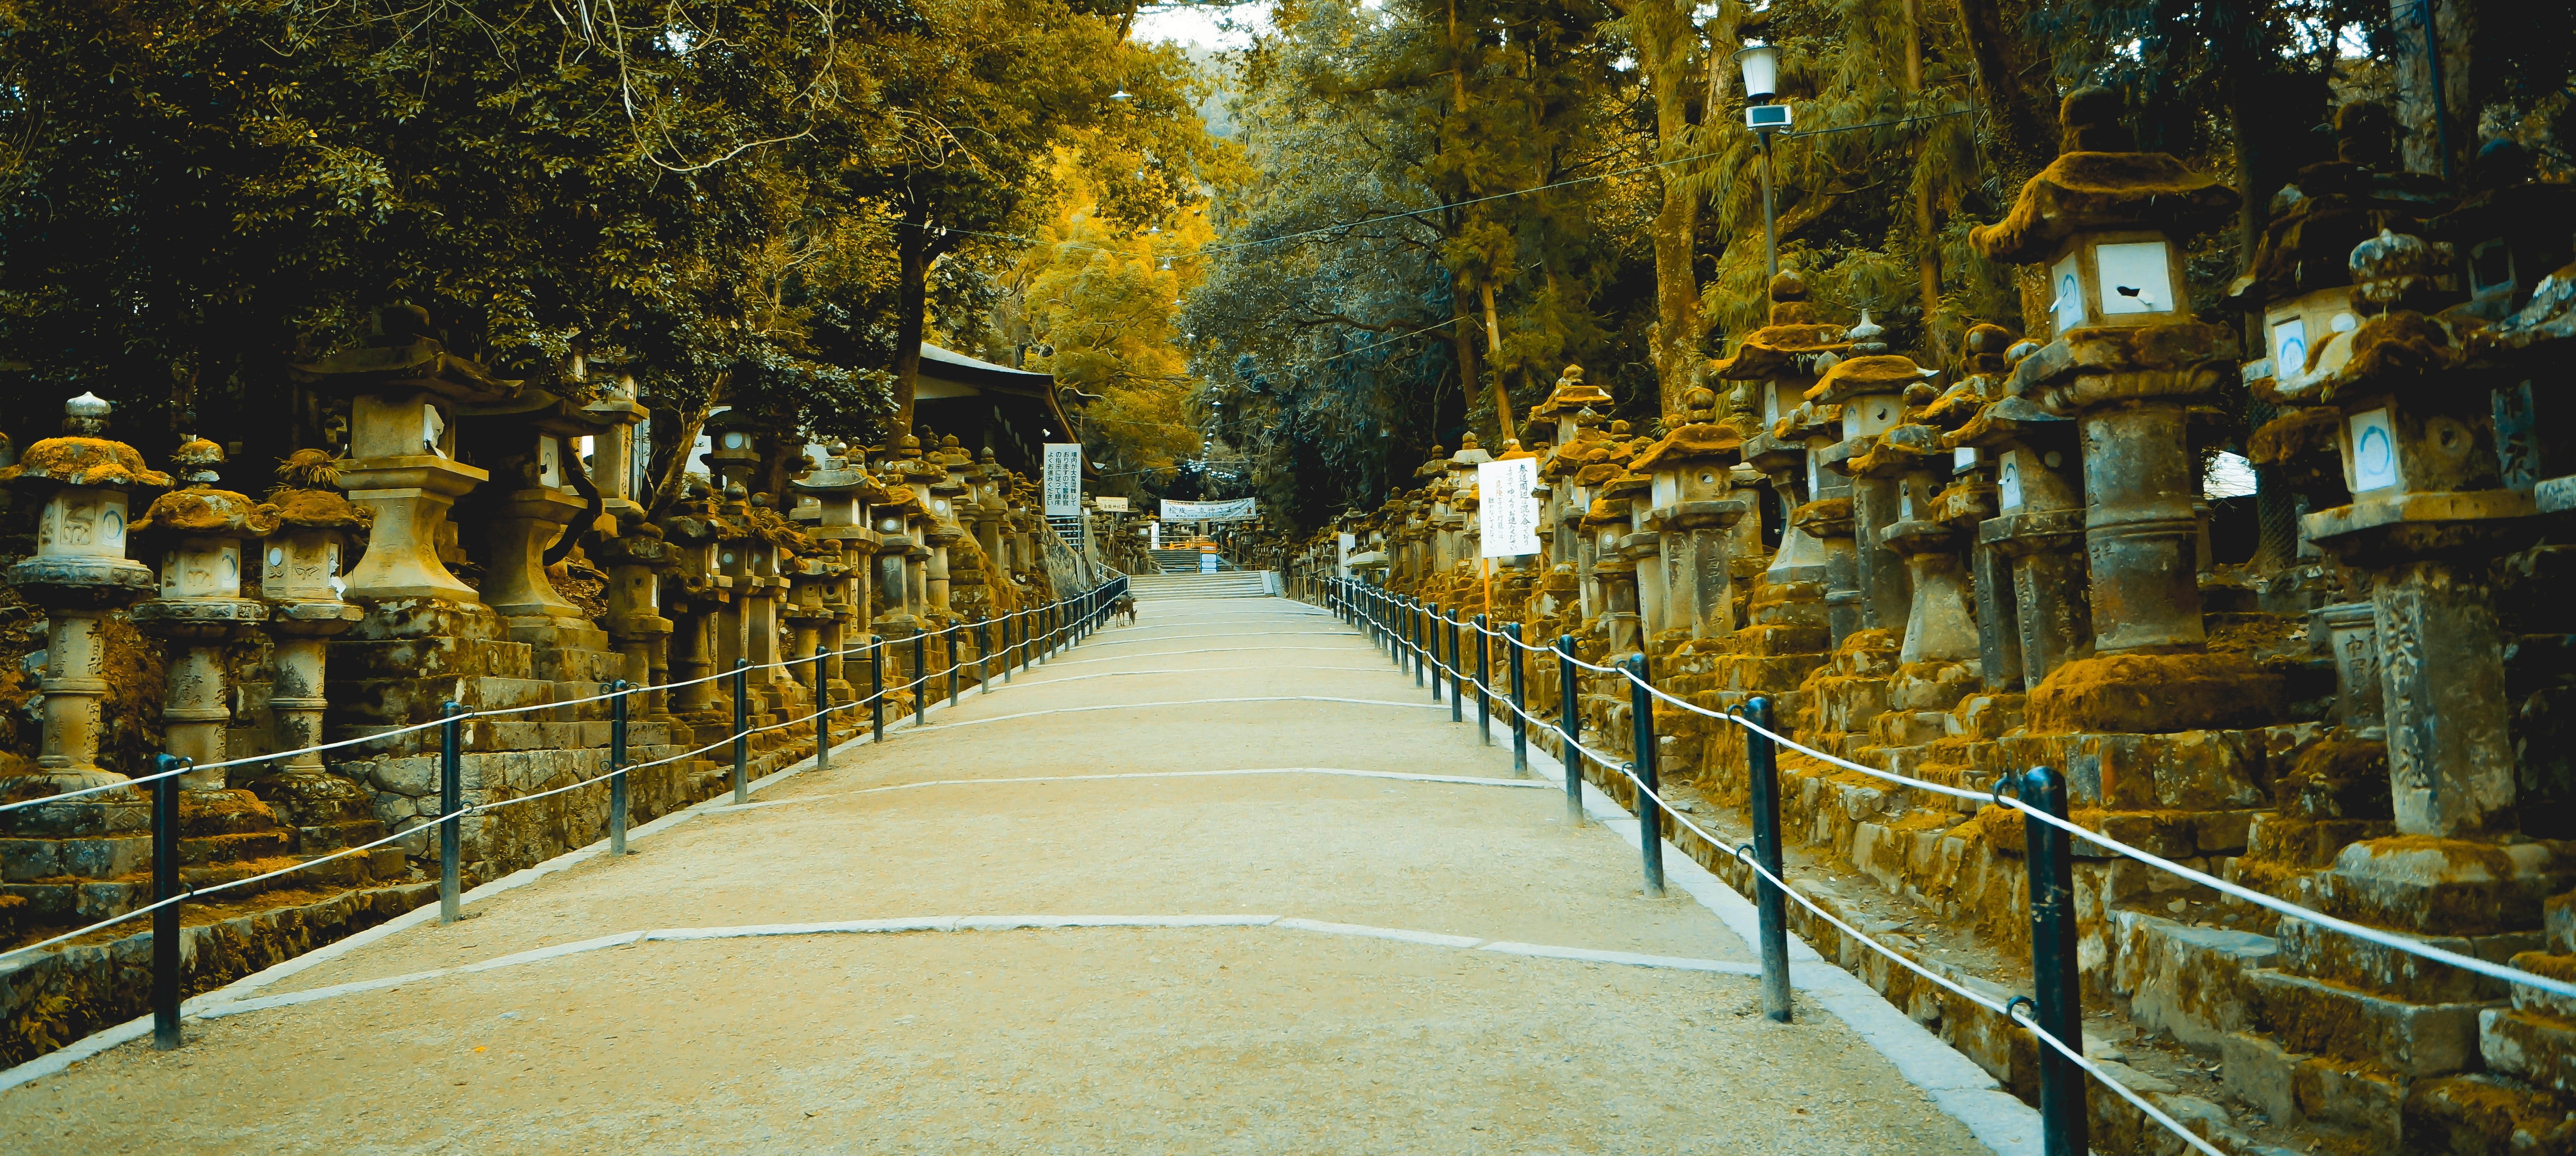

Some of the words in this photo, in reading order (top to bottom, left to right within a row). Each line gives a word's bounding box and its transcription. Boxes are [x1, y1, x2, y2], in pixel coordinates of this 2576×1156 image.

[1518, 463, 1531, 546] 参道周辺は混み合っており
